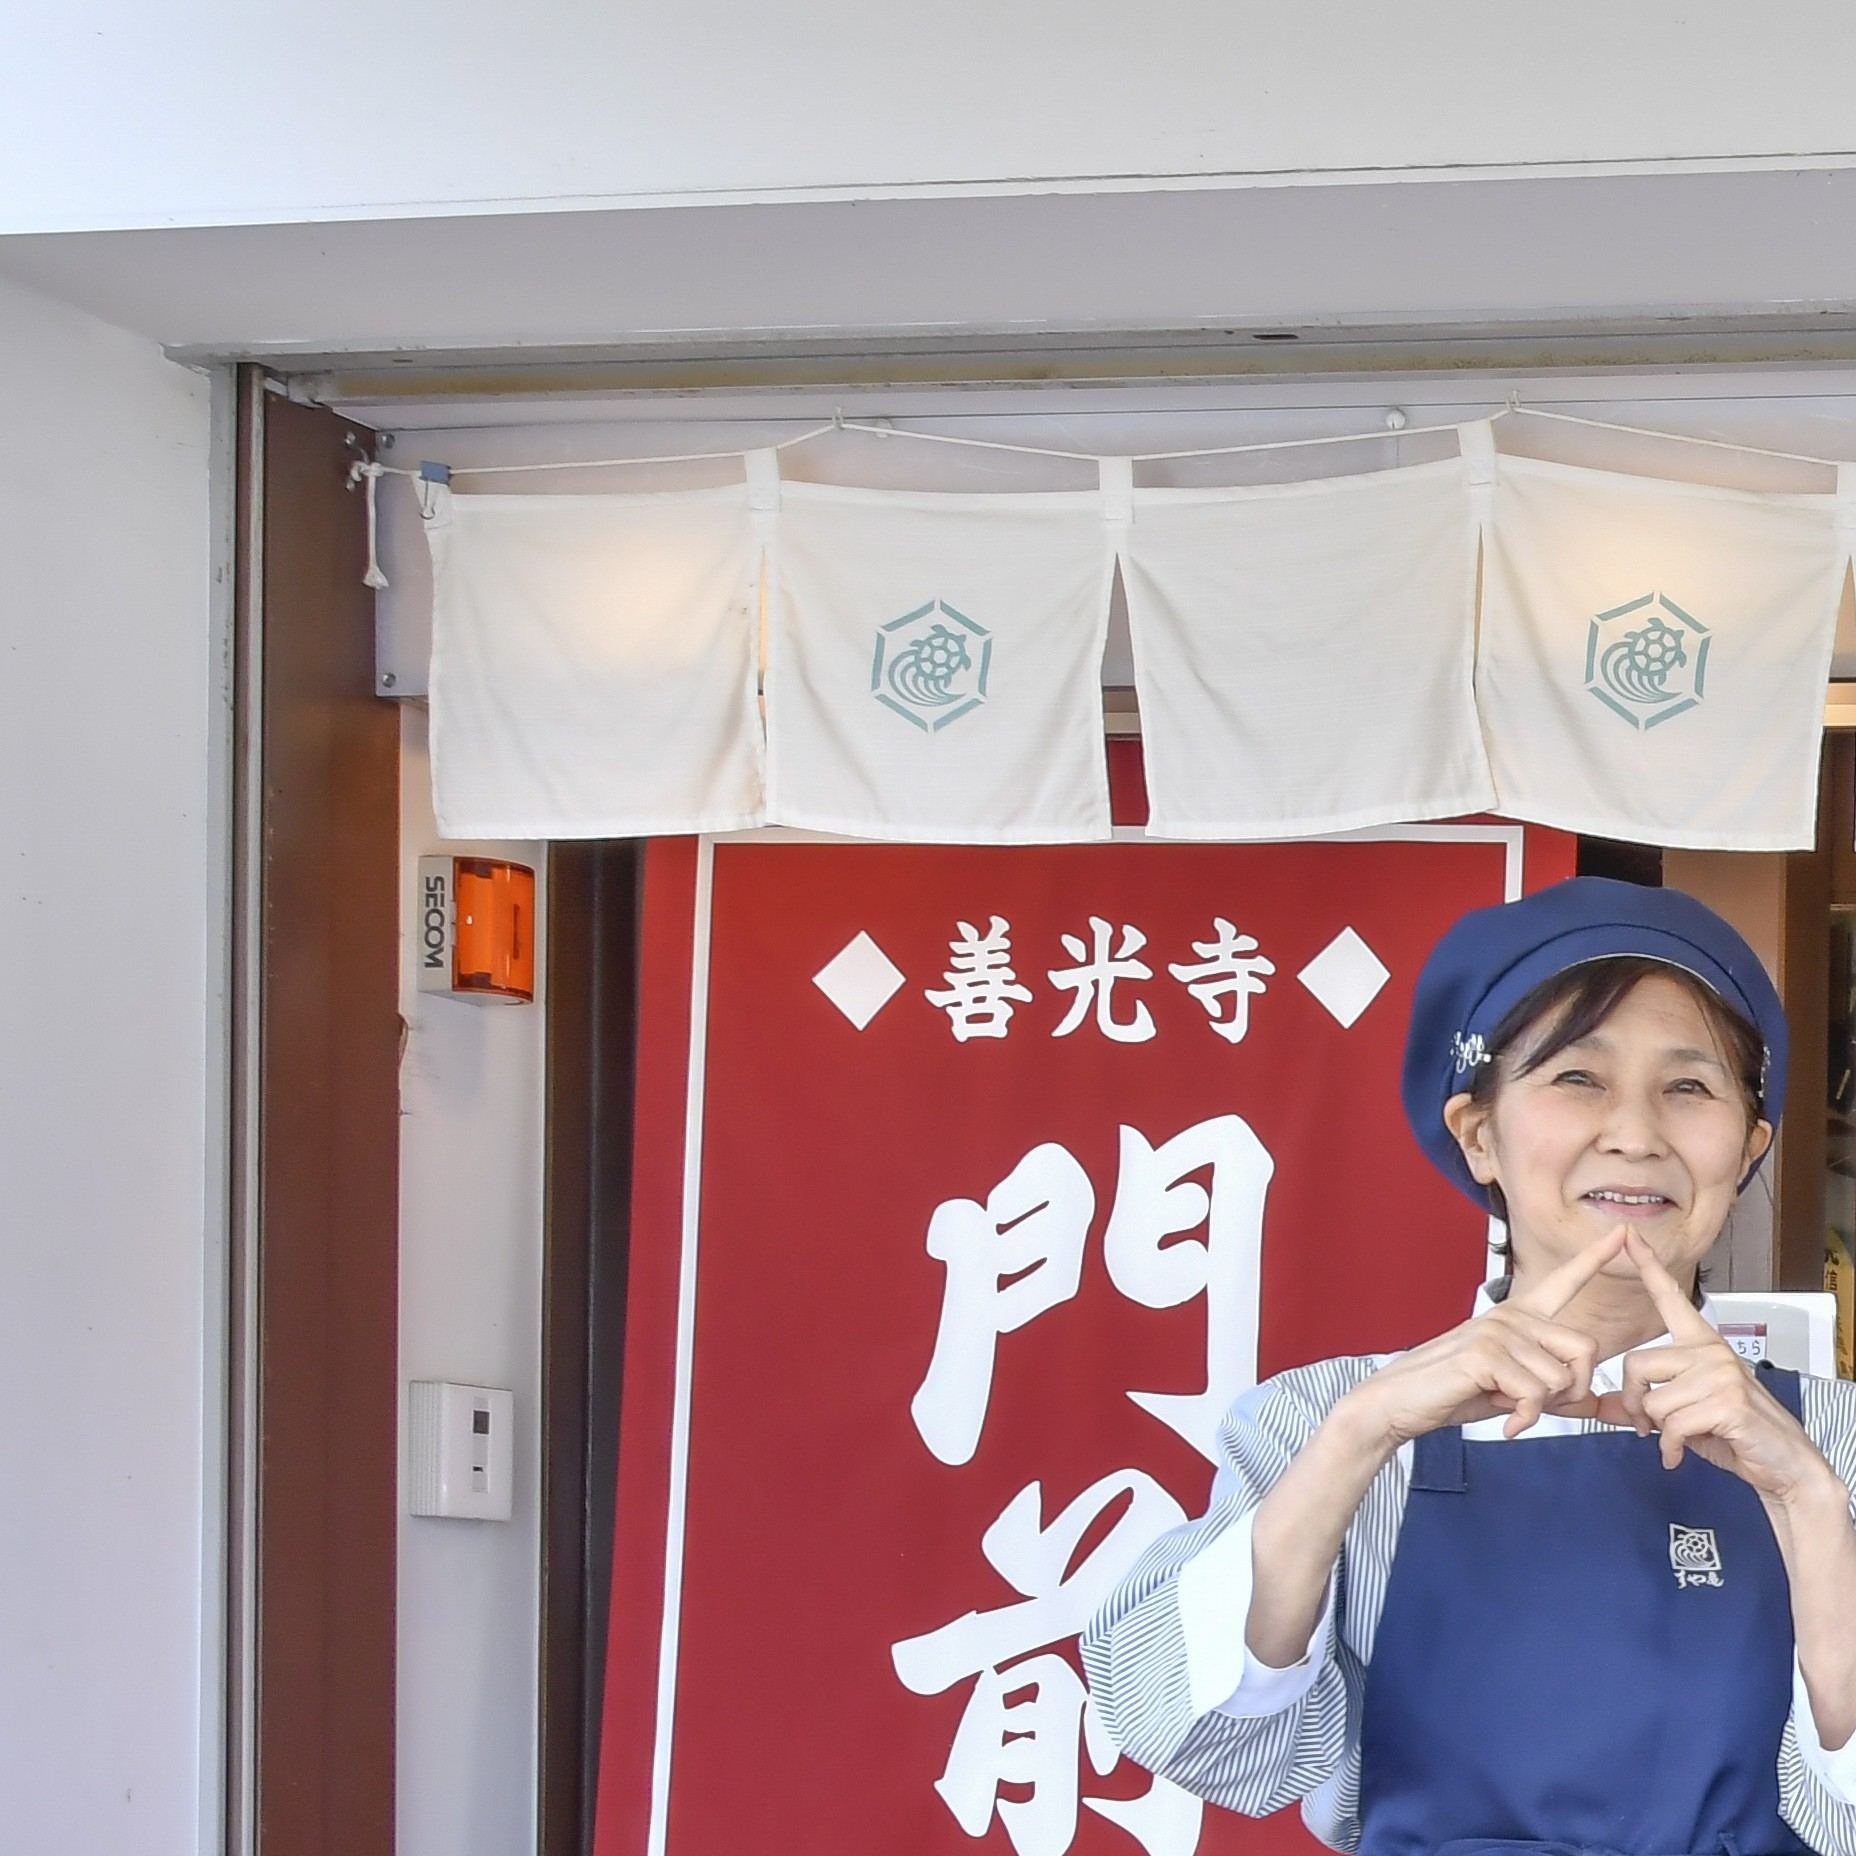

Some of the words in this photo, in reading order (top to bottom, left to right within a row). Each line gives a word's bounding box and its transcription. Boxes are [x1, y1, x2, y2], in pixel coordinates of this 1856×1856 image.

[424, 875, 445, 969] SECOM
[923, 916, 1277, 1044] 善光寺
